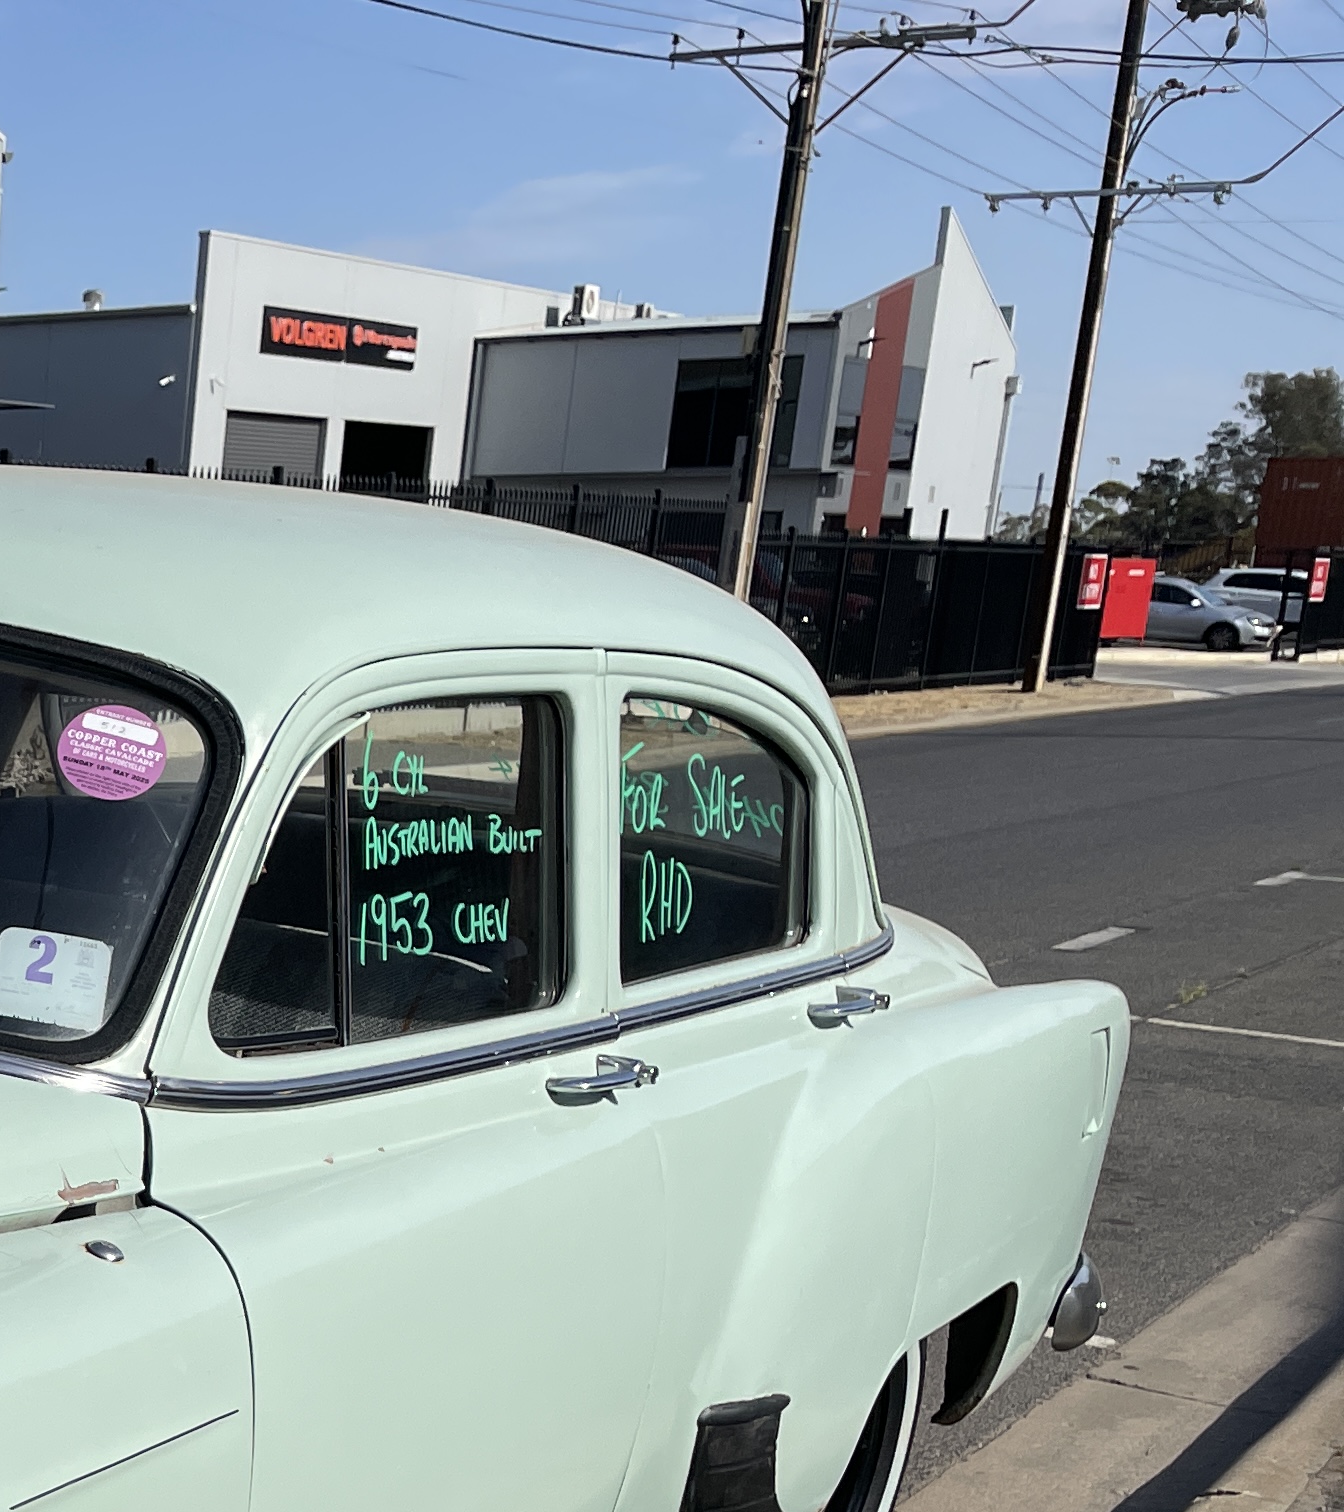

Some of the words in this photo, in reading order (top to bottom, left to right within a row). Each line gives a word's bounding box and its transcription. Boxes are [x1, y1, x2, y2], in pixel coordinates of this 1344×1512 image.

[269, 315, 348, 350] VOLGREN
[62, 755, 94, 768] SUNDAY
[112, 768, 130, 779] MAY
[67, 728, 117, 748] COPPER
[120, 742, 164, 762] COAST
[69, 739, 104, 752] CLASSIC
[104, 748, 155, 768] CAVALCADE
[362, 730, 379, 810] 6
[393, 751, 429, 797] CYL
[620, 741, 666, 834] FOR
[687, 753, 746, 840] SALE
[365, 814, 474, 870] AUSTRALIAN
[487, 813, 543, 855] BUILT
[641, 850, 693, 943] RHD
[360, 891, 434, 966] 1953
[454, 897, 510, 944] CHEV
[24, 935, 58, 985] 2
